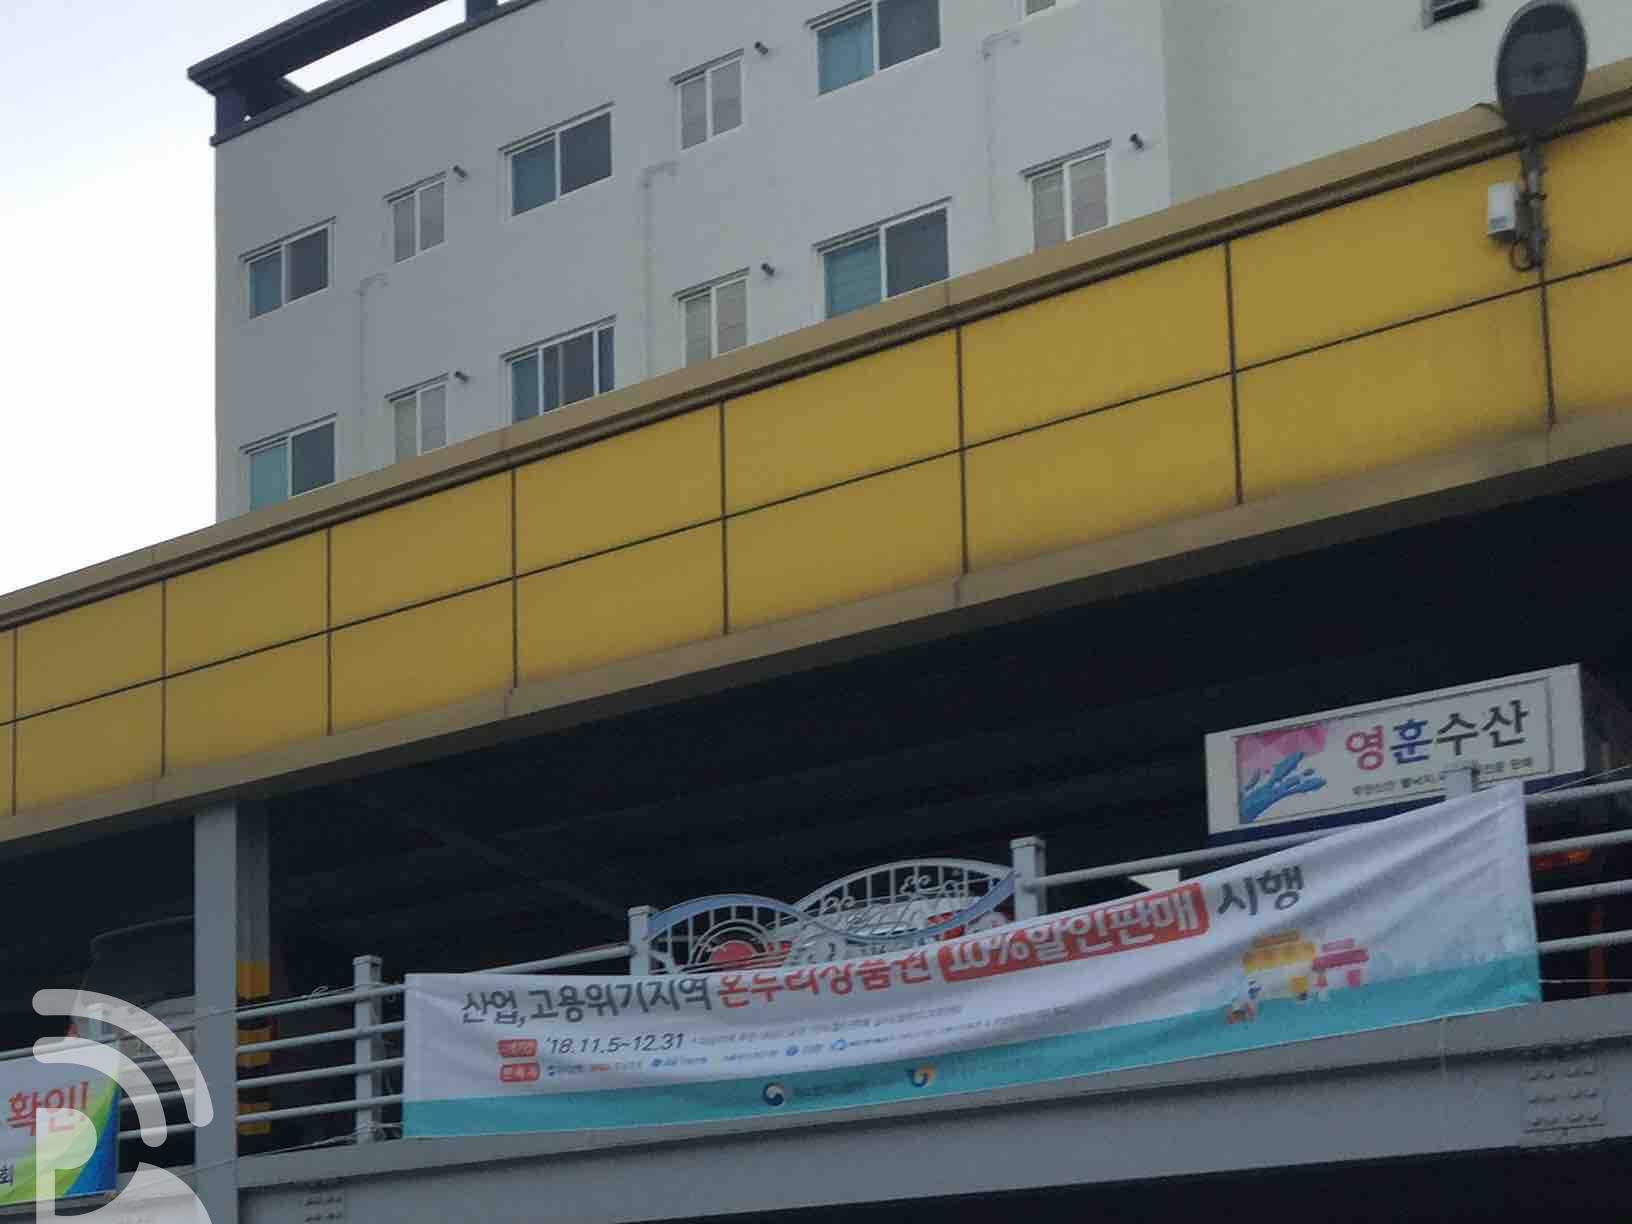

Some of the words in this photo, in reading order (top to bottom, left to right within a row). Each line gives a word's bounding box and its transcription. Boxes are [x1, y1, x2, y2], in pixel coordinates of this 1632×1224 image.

[1345, 699, 1529, 771] 영훈수산
[1218, 865, 1305, 916] 시행
[8, 1080, 89, 1137] 확인!
